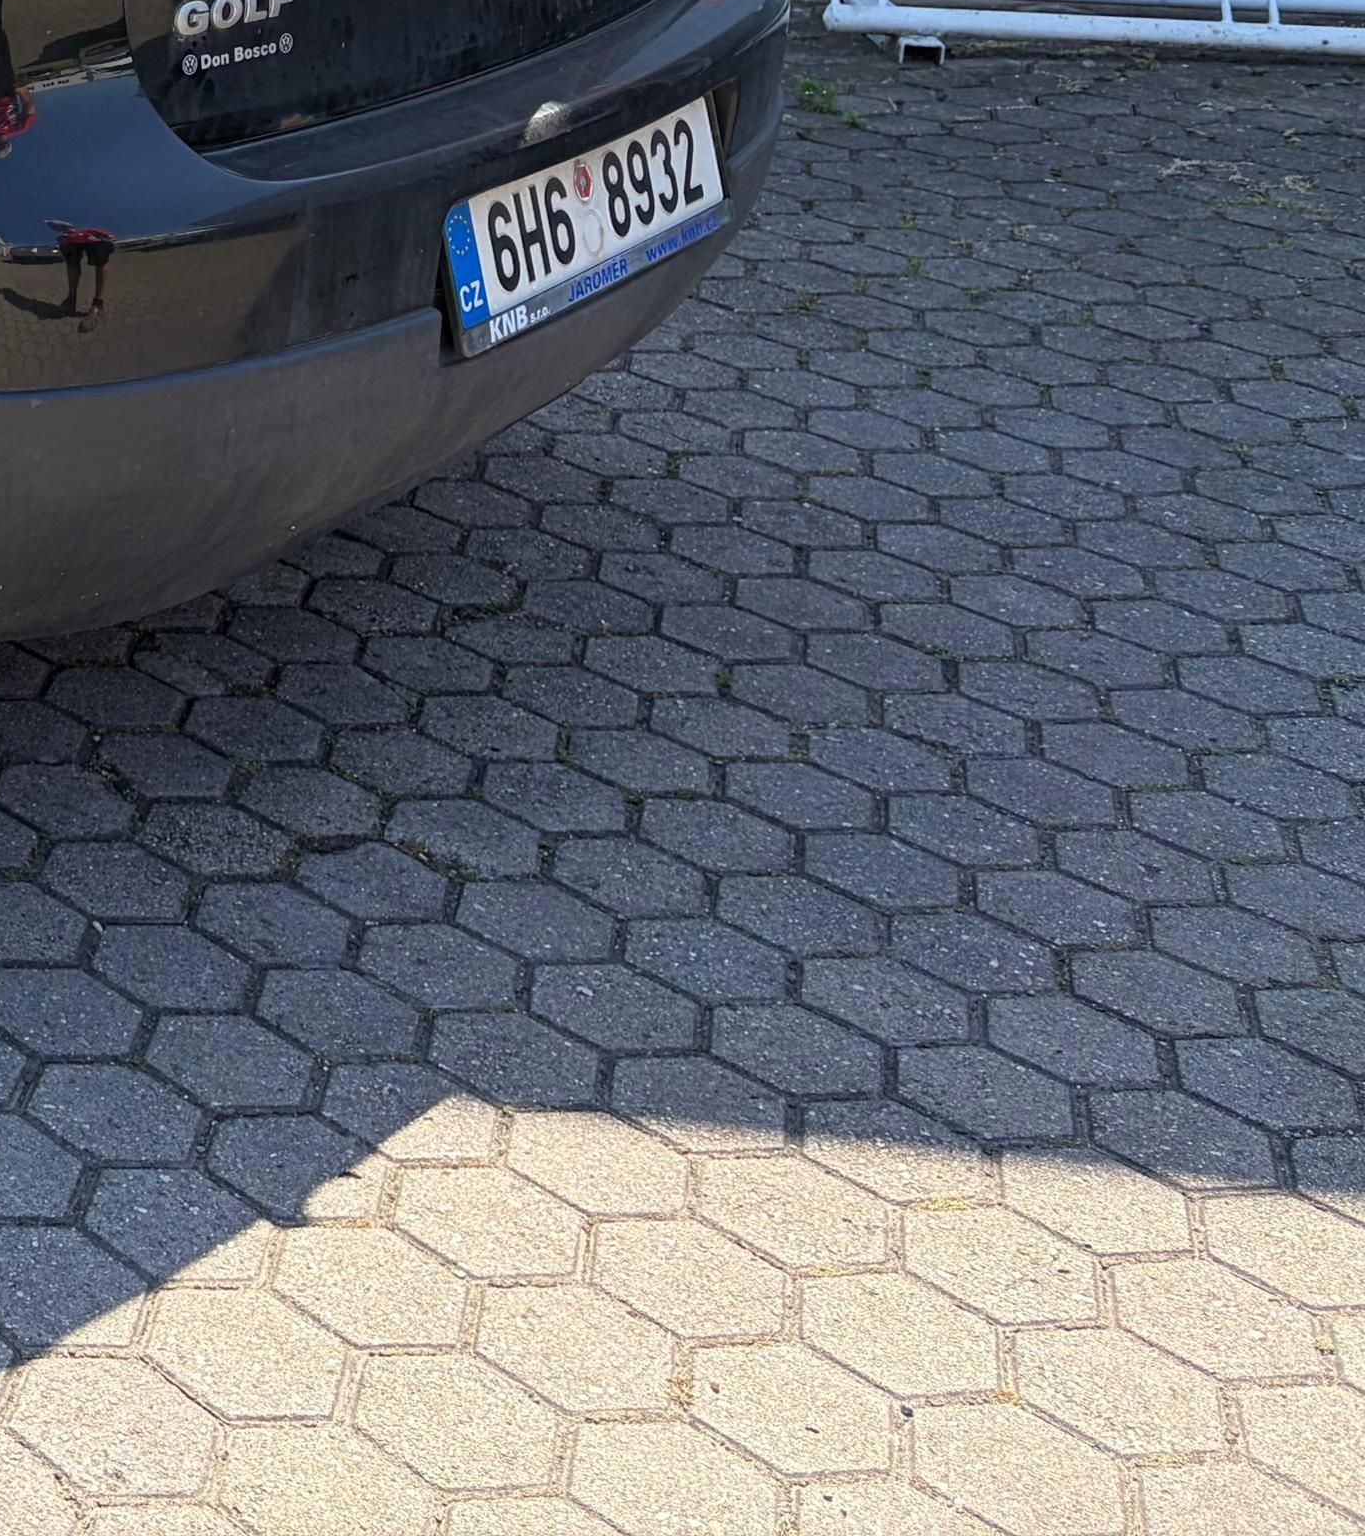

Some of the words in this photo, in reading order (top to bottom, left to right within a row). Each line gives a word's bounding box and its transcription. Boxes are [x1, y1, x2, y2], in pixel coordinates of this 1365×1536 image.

[200, 53, 229, 70] Don
[234, 43, 277, 62] Bosco
[487, 176, 576, 293] 6H6
[601, 118, 704, 238] 8932
[459, 280, 484, 313] CZ
[489, 305, 529, 343] KNB
[530, 306, 550, 323] s.r.o.
[646, 213, 719, 262] www.knb.cz
